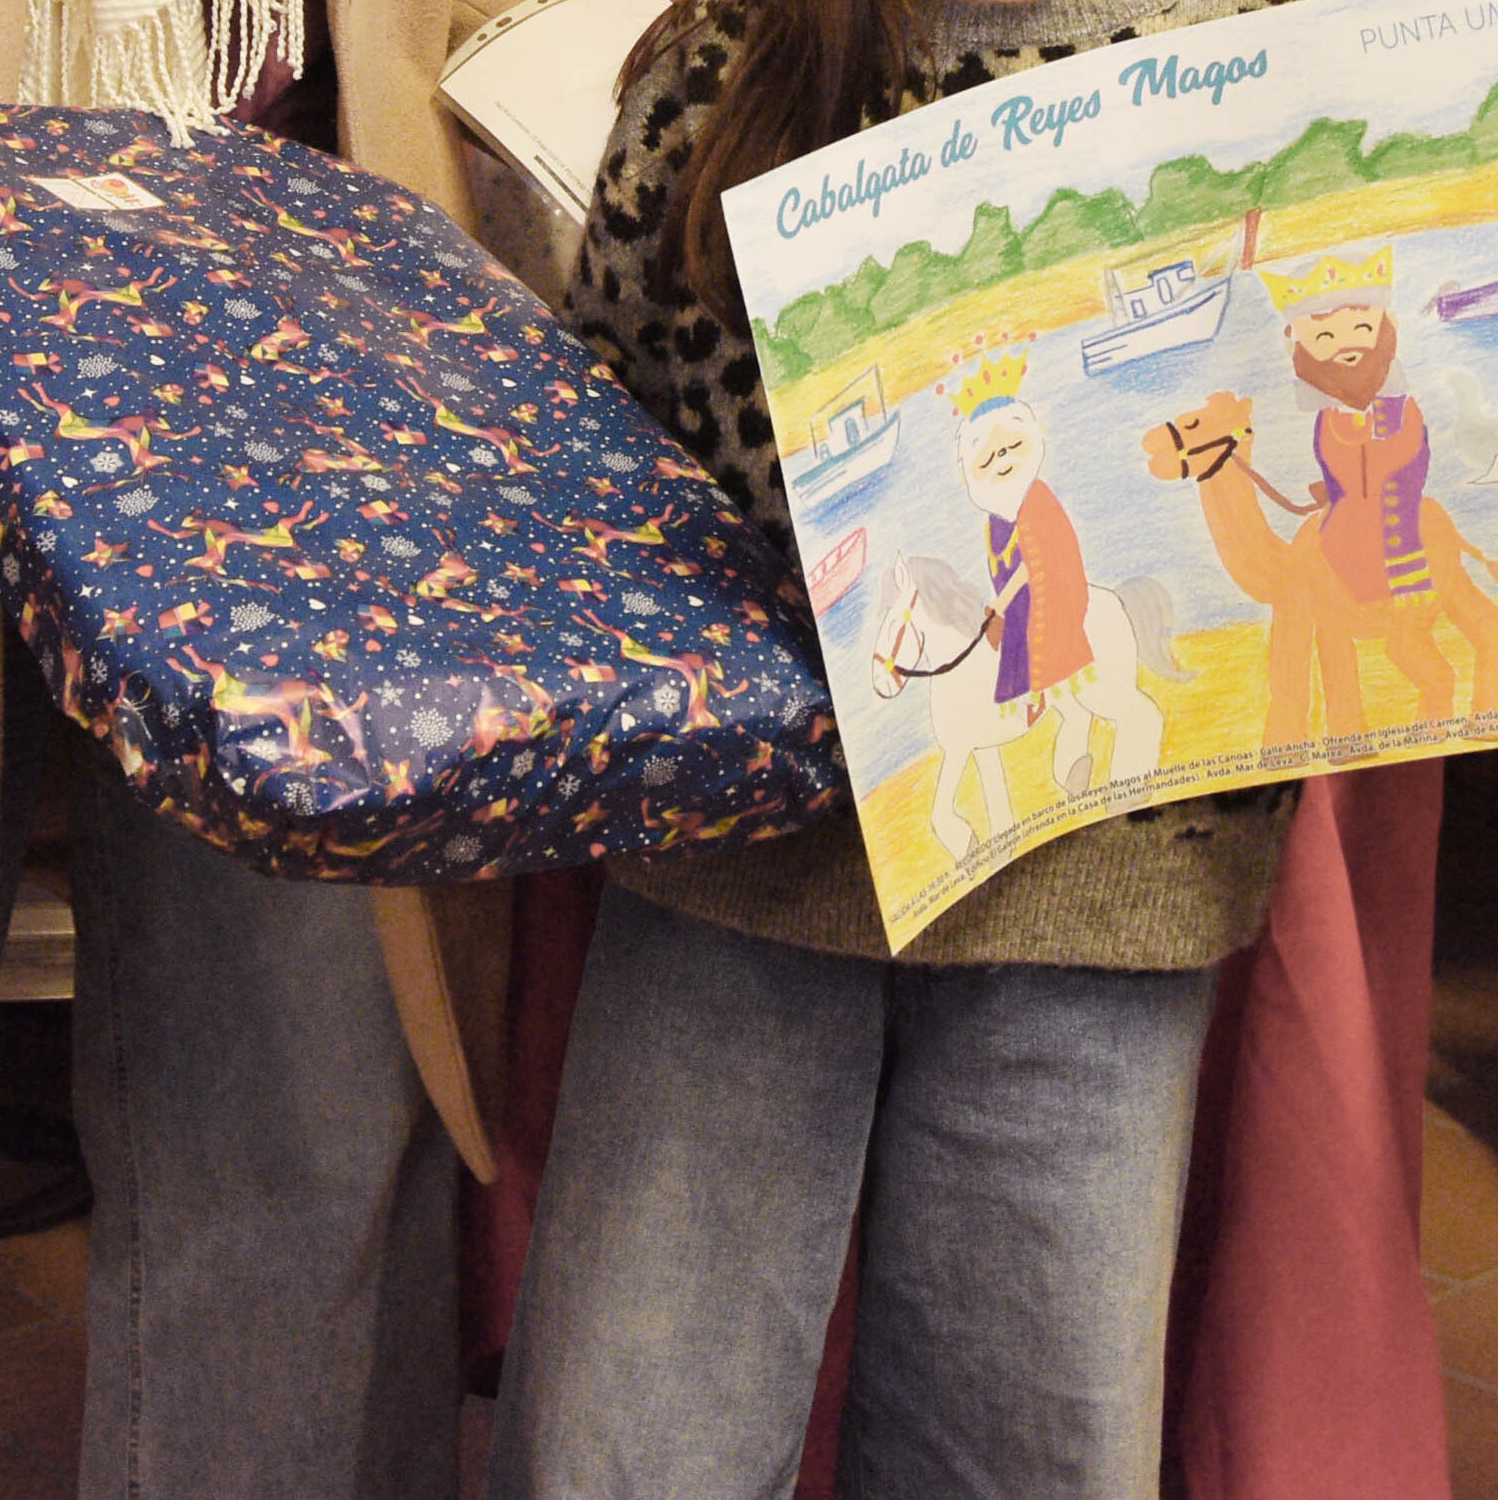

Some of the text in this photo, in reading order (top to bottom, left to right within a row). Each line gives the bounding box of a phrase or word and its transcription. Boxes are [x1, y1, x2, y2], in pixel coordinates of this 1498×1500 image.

[1360, 11, 1458, 53] PUNTA
[776, 48, 1269, 240] Cabalgata de Reyes Magos
[1031, 803, 1054, 822] barco
[1055, 797, 1067, 810] de
[1067, 793, 1081, 804] los
[1080, 785, 1108, 799] Reyes
[1110, 776, 1141, 790] Magos
[1143, 768, 1152, 780] al
[1153, 762, 1186, 777] Muelle
[1188, 759, 1201, 771] de
[1202, 756, 1217, 767] las
[1218, 750, 1253, 764] Canoas
[1259, 745, 1283, 758] Calle
[1286, 739, 1316, 753] Ancha
[1322, 733, 1362, 747] Ofrenda
[1364, 729, 1377, 739] en
[1378, 723, 1410, 739] Iglesia
[1412, 720, 1429, 732] del
[1429, 715, 1468, 729] Carmen
[1056, 811, 1068, 822] en
[1068, 805, 1077, 817] la
[1077, 799, 1100, 813] Casa
[1100, 794, 1113, 806] de
[1113, 790, 1128, 803] las
[1235, 762, 1255, 774] Mar
[1256, 759, 1269, 771] de
[1271, 756, 1294, 769] Leva
[1377, 740, 1391, 751] de
[1392, 737, 1401, 748] la
[1403, 732, 1439, 746] Marina
[1474, 723, 1487, 736] de
